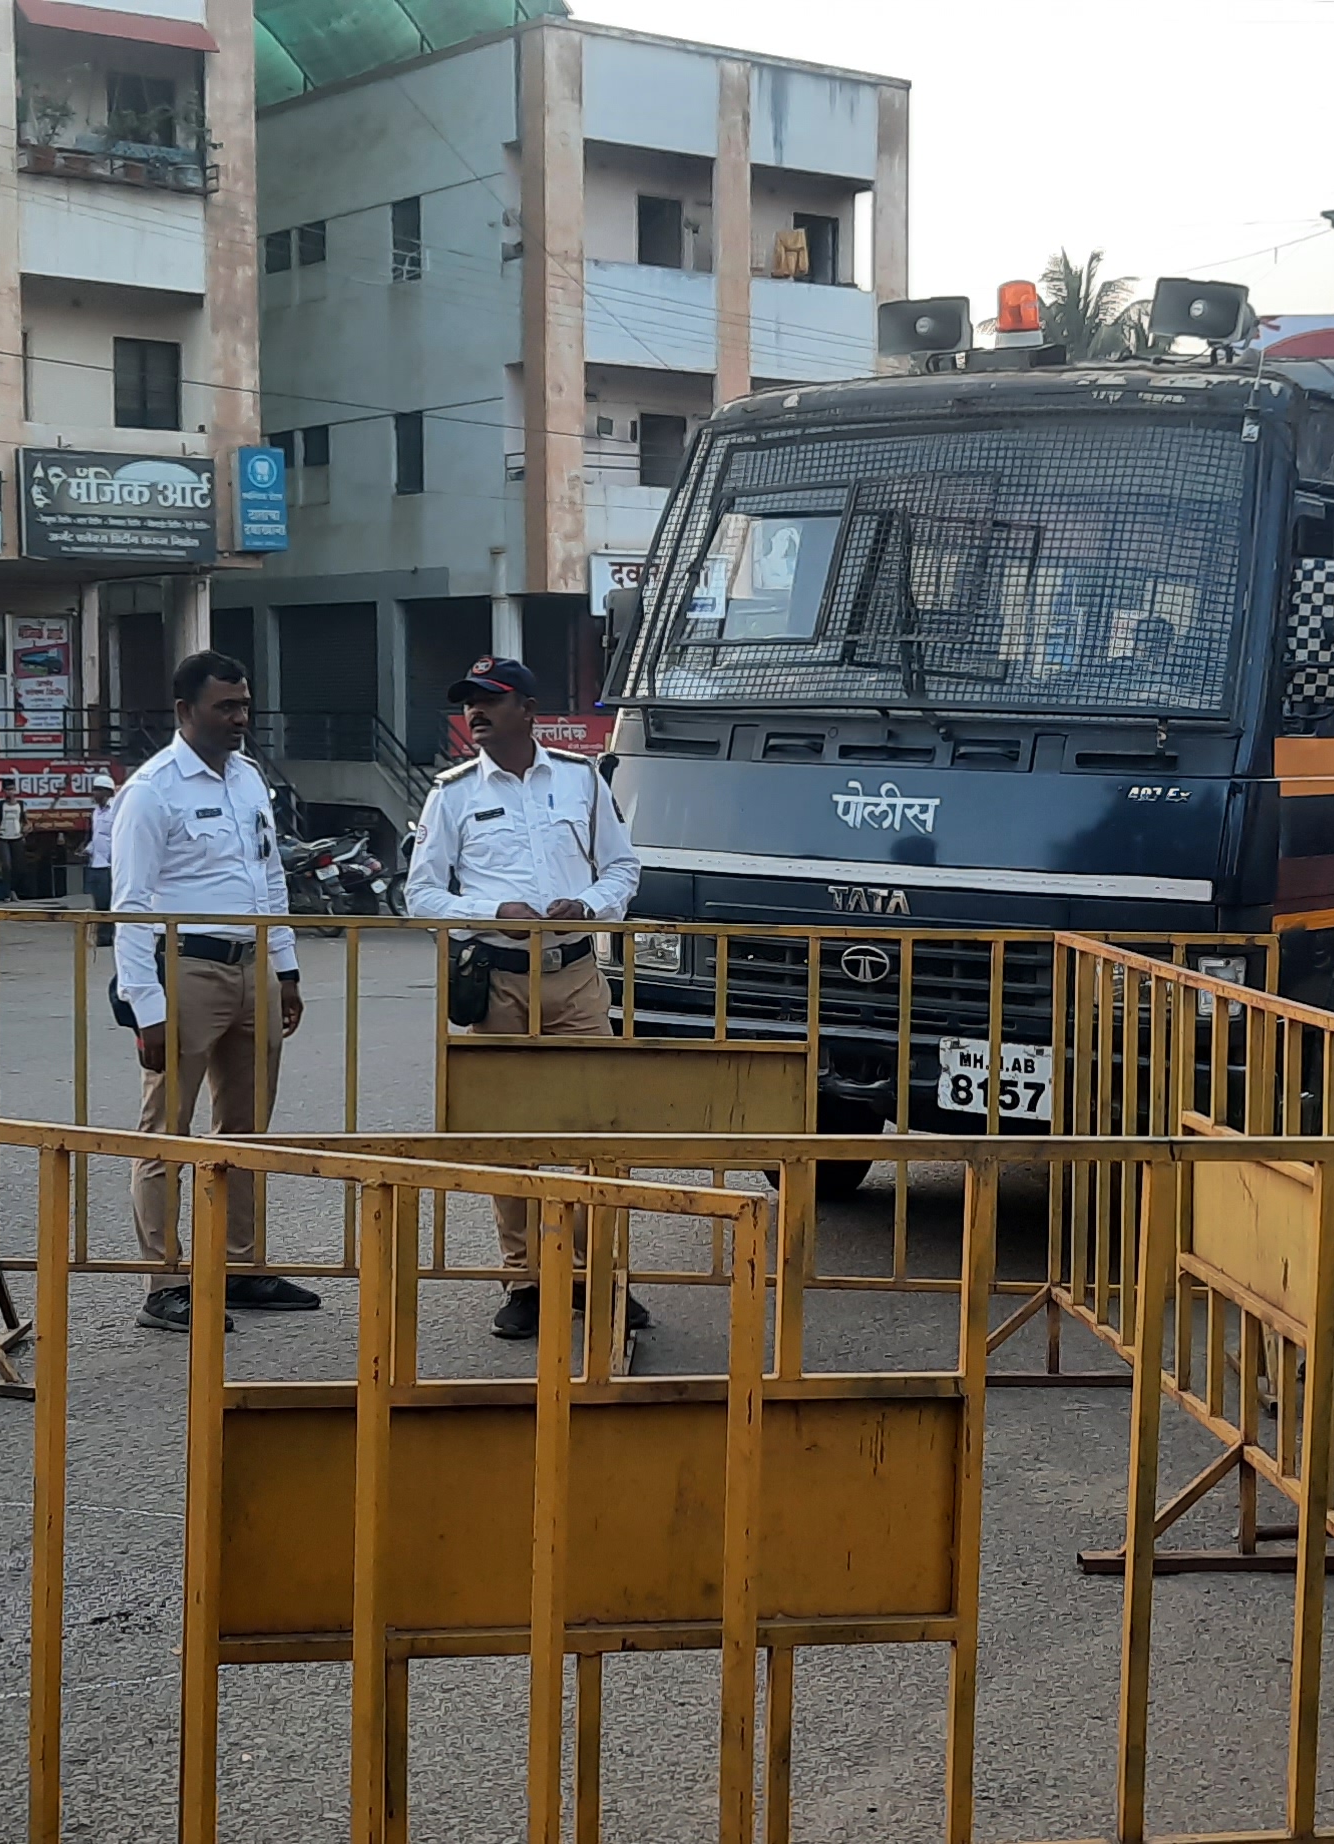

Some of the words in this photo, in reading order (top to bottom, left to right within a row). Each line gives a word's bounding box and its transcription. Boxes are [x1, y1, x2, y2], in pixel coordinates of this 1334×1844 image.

[156, 472, 212, 508] आर्ट
[831, 781, 941, 834] पोलीस
[827, 886, 912, 916] TATA
[951, 1074, 1046, 1112] 8157
